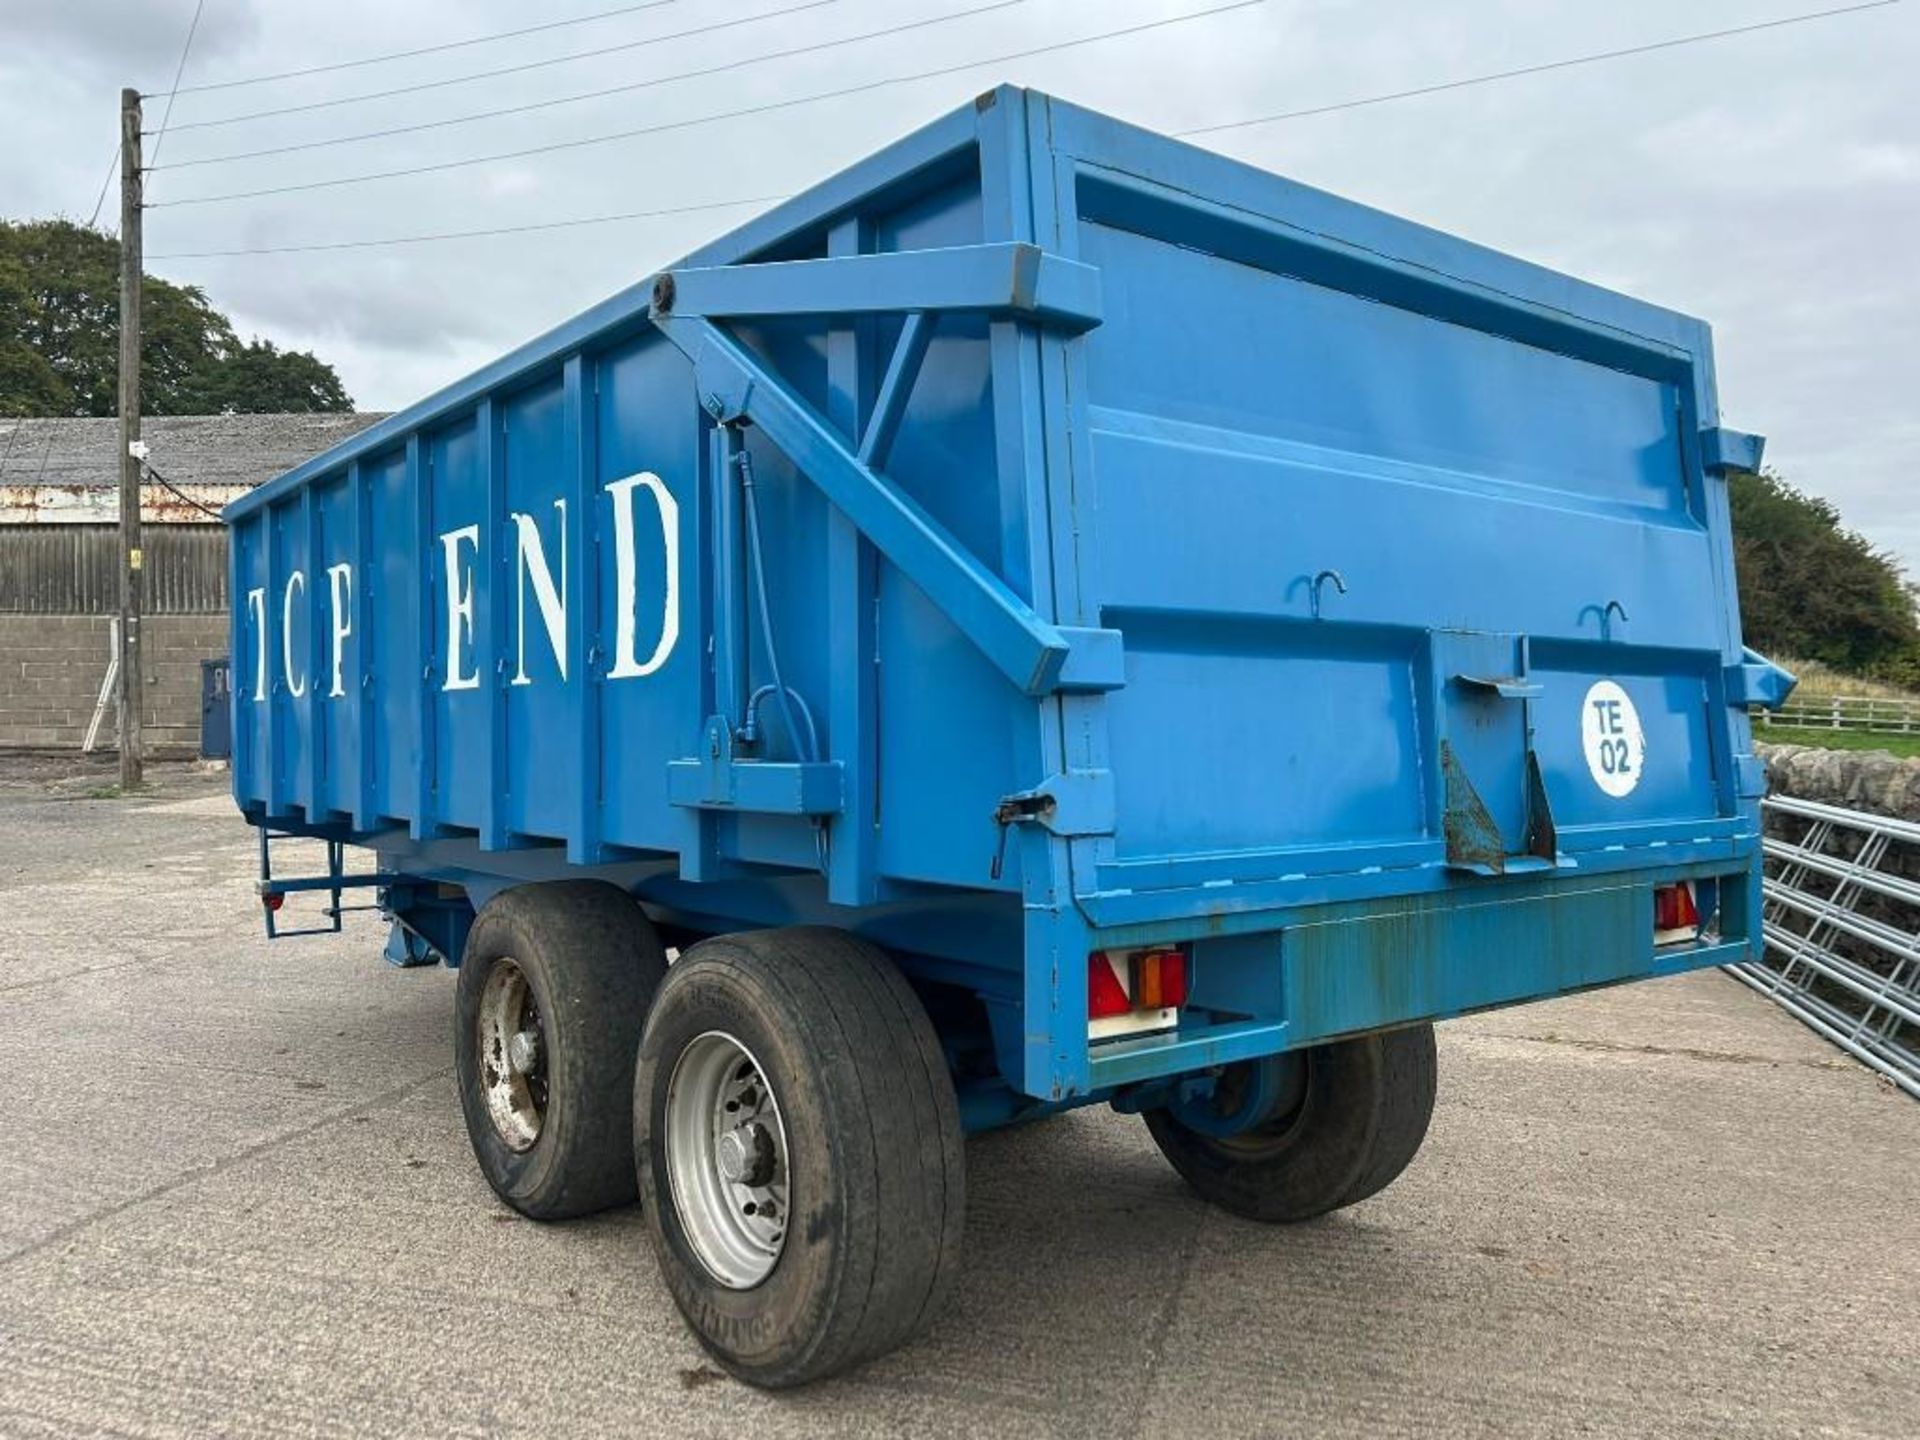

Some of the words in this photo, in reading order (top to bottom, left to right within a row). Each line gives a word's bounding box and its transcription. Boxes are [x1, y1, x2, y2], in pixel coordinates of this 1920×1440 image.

[440, 471, 679, 692] END
[1592, 700, 1624, 734] TE
[1600, 738, 1631, 774] 02
